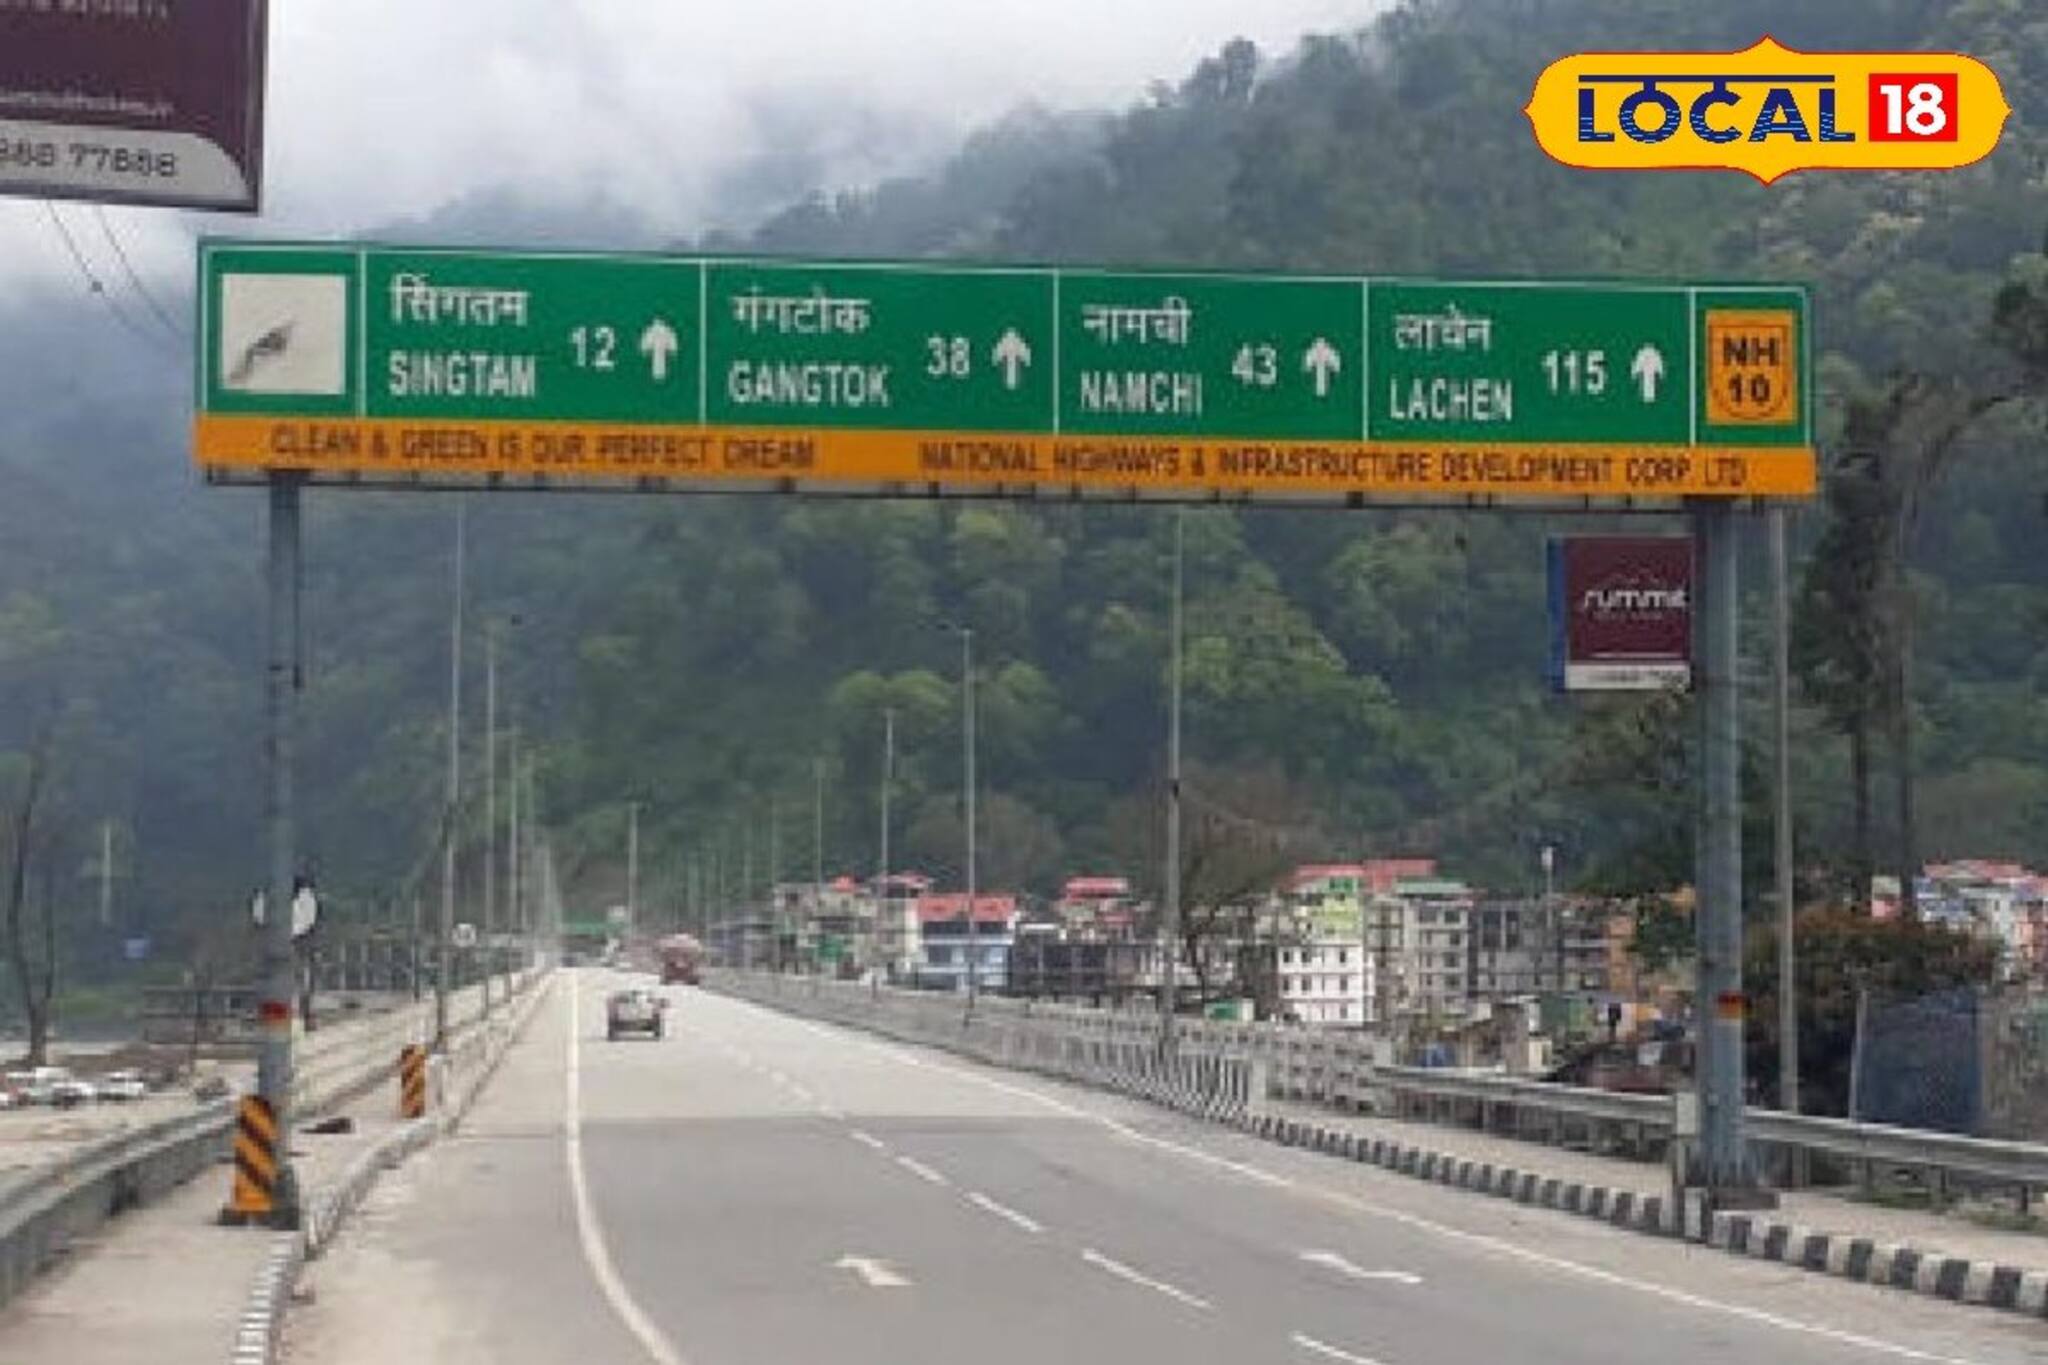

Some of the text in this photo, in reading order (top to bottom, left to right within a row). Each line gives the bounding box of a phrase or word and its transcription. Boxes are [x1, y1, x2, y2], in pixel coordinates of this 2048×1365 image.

[390, 272, 531, 327] सिंगतम
[730, 286, 872, 334] गंगटोक
[1082, 296, 1192, 346] नामची
[569, 326, 617, 370] 12
[927, 336, 971, 378] 38
[1231, 343, 1278, 386] 43
[1722, 336, 1780, 367] NH
[389, 350, 537, 398] SINGTAM
[729, 360, 889, 407] GANGTOK
[1080, 371, 1203, 416] NAMCHI
[1542, 349, 1606, 395] 115
[1728, 373, 1770, 406] 10
[1390, 376, 1512, 421] LACHEN
[270, 424, 814, 470] CLEAN & GREEN IS OUR PERFECT DREAM
[919, 441, 1049, 472] NATIONAL
[1053, 443, 1179, 477] HIGHWAYS
[1190, 447, 1205, 477] &
[1217, 446, 1432, 482] INFRASTRUCTURE
[1442, 452, 1612, 483] DEVELOPMENT
[1704, 457, 1748, 488] LTD
